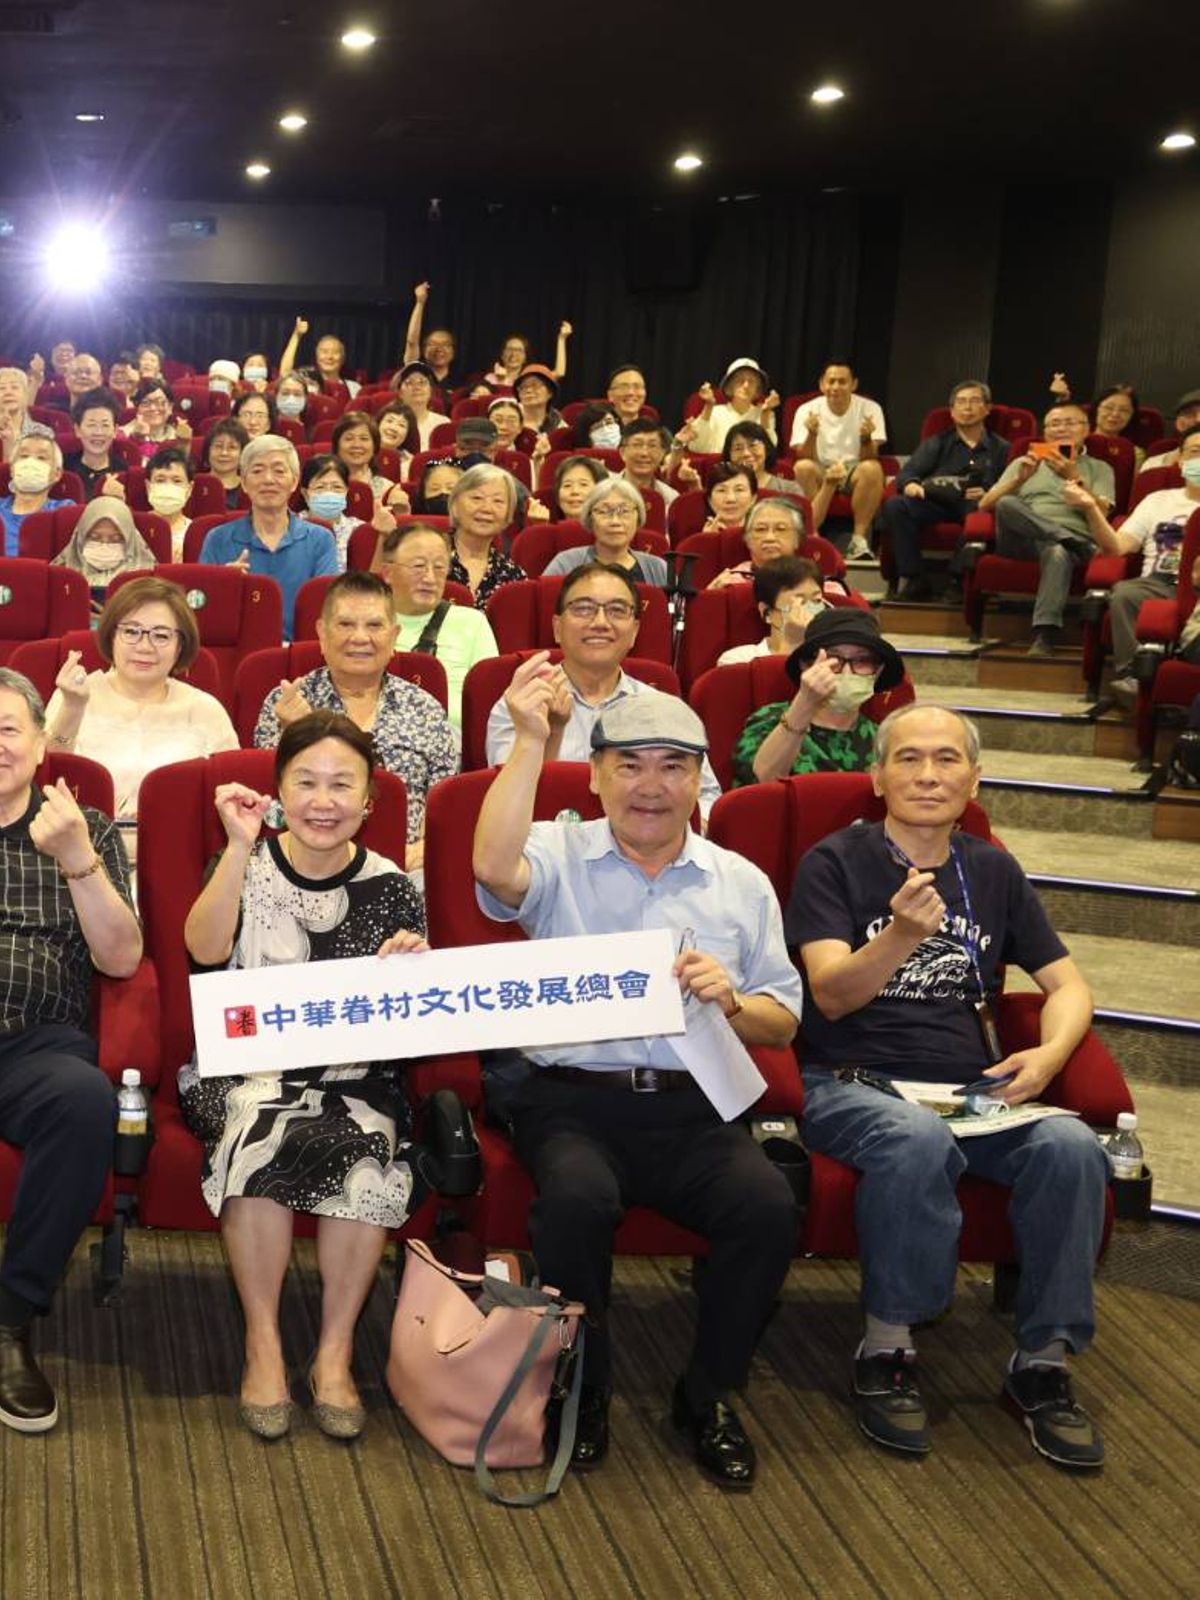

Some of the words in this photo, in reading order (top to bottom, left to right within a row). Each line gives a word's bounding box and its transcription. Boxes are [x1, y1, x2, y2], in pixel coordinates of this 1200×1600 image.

[64, 584, 70, 596] 1
[252, 590, 261, 602] 3
[72, 784, 80, 800] 1
[262, 969, 651, 1032] 中華眷村文化發展總會
